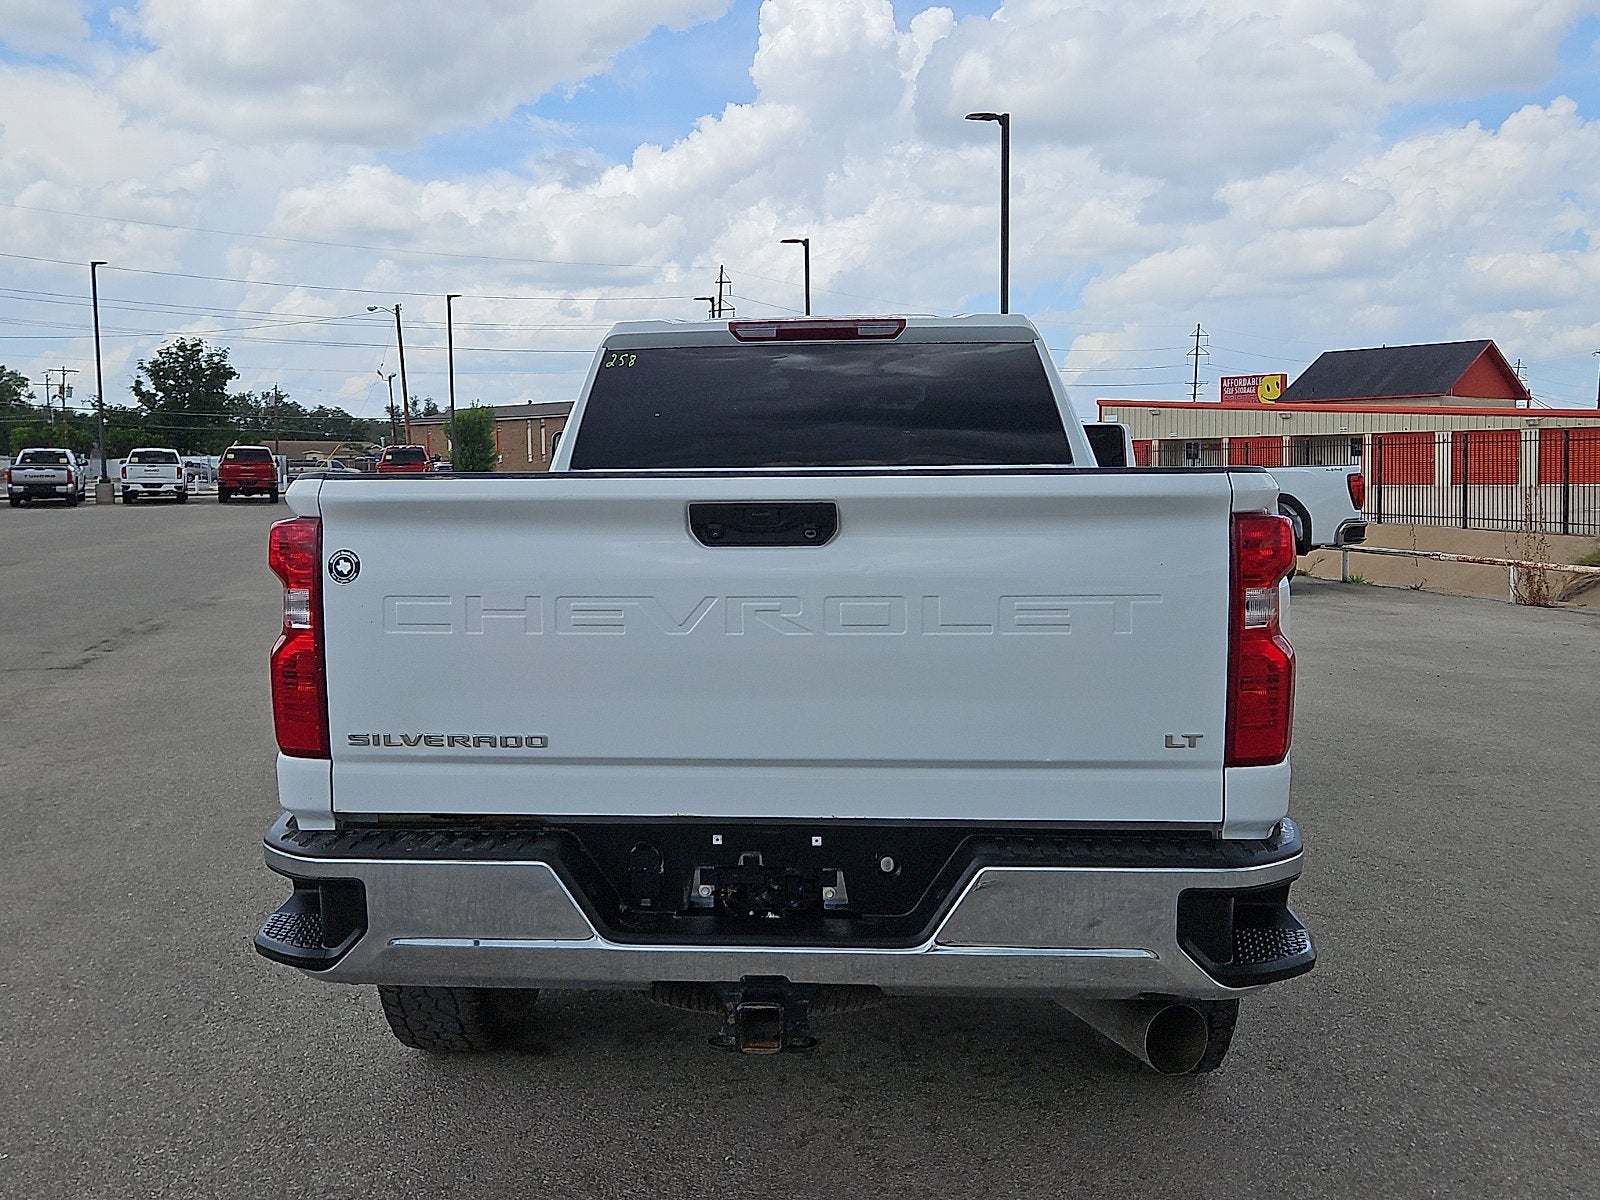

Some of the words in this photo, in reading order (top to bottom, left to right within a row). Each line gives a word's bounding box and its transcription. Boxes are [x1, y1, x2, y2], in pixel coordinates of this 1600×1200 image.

[605, 352, 637, 368] 258
[1222, 377, 1262, 388] AFFORDABLE
[1223, 387, 1235, 395] SELF
[1235, 386, 1256, 395] STORAGE
[383, 595, 1164, 637] CHEVROLET
[347, 733, 549, 749] SILVERADO
[1164, 733, 1204, 749] LT
